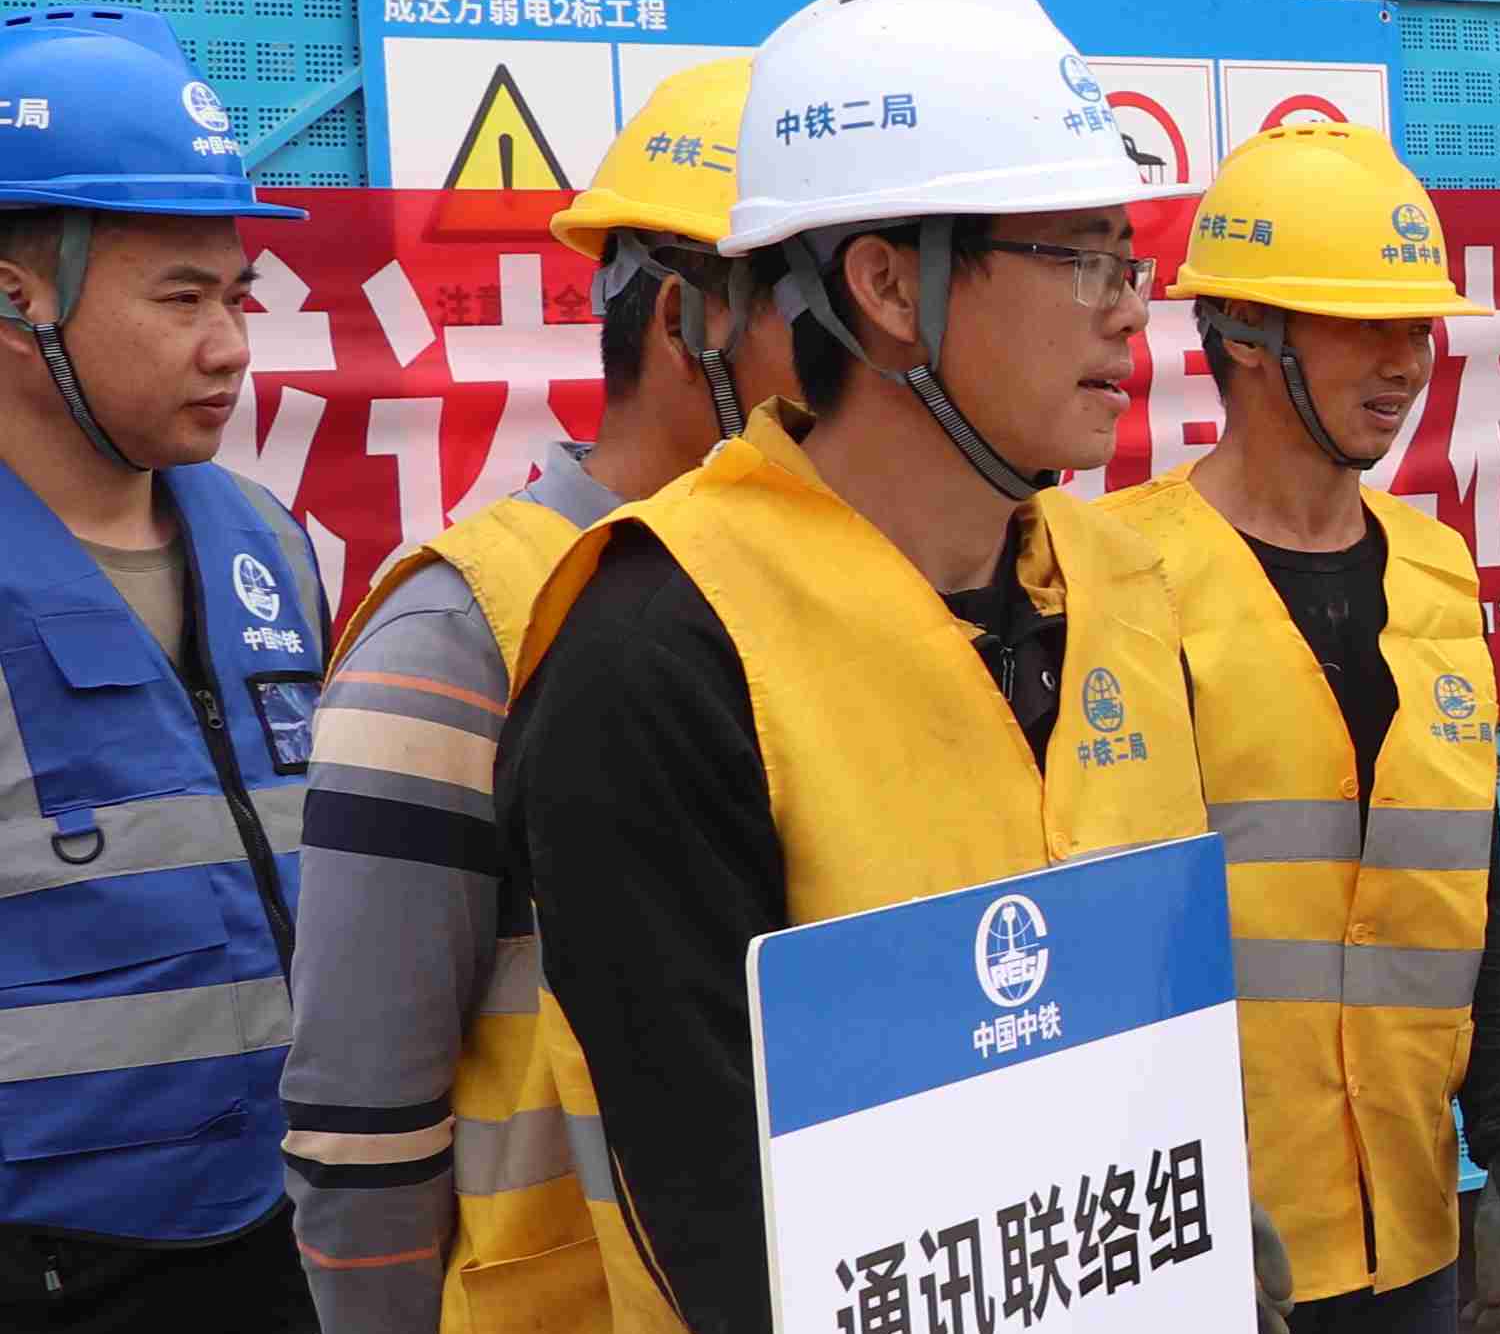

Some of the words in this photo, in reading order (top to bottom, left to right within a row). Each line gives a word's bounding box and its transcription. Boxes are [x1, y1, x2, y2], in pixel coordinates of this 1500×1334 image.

[776, 94, 918, 145] 中铁二局
[1077, 731, 1148, 768] 中铁二局
[973, 1002, 1062, 1059] 中国中铁
